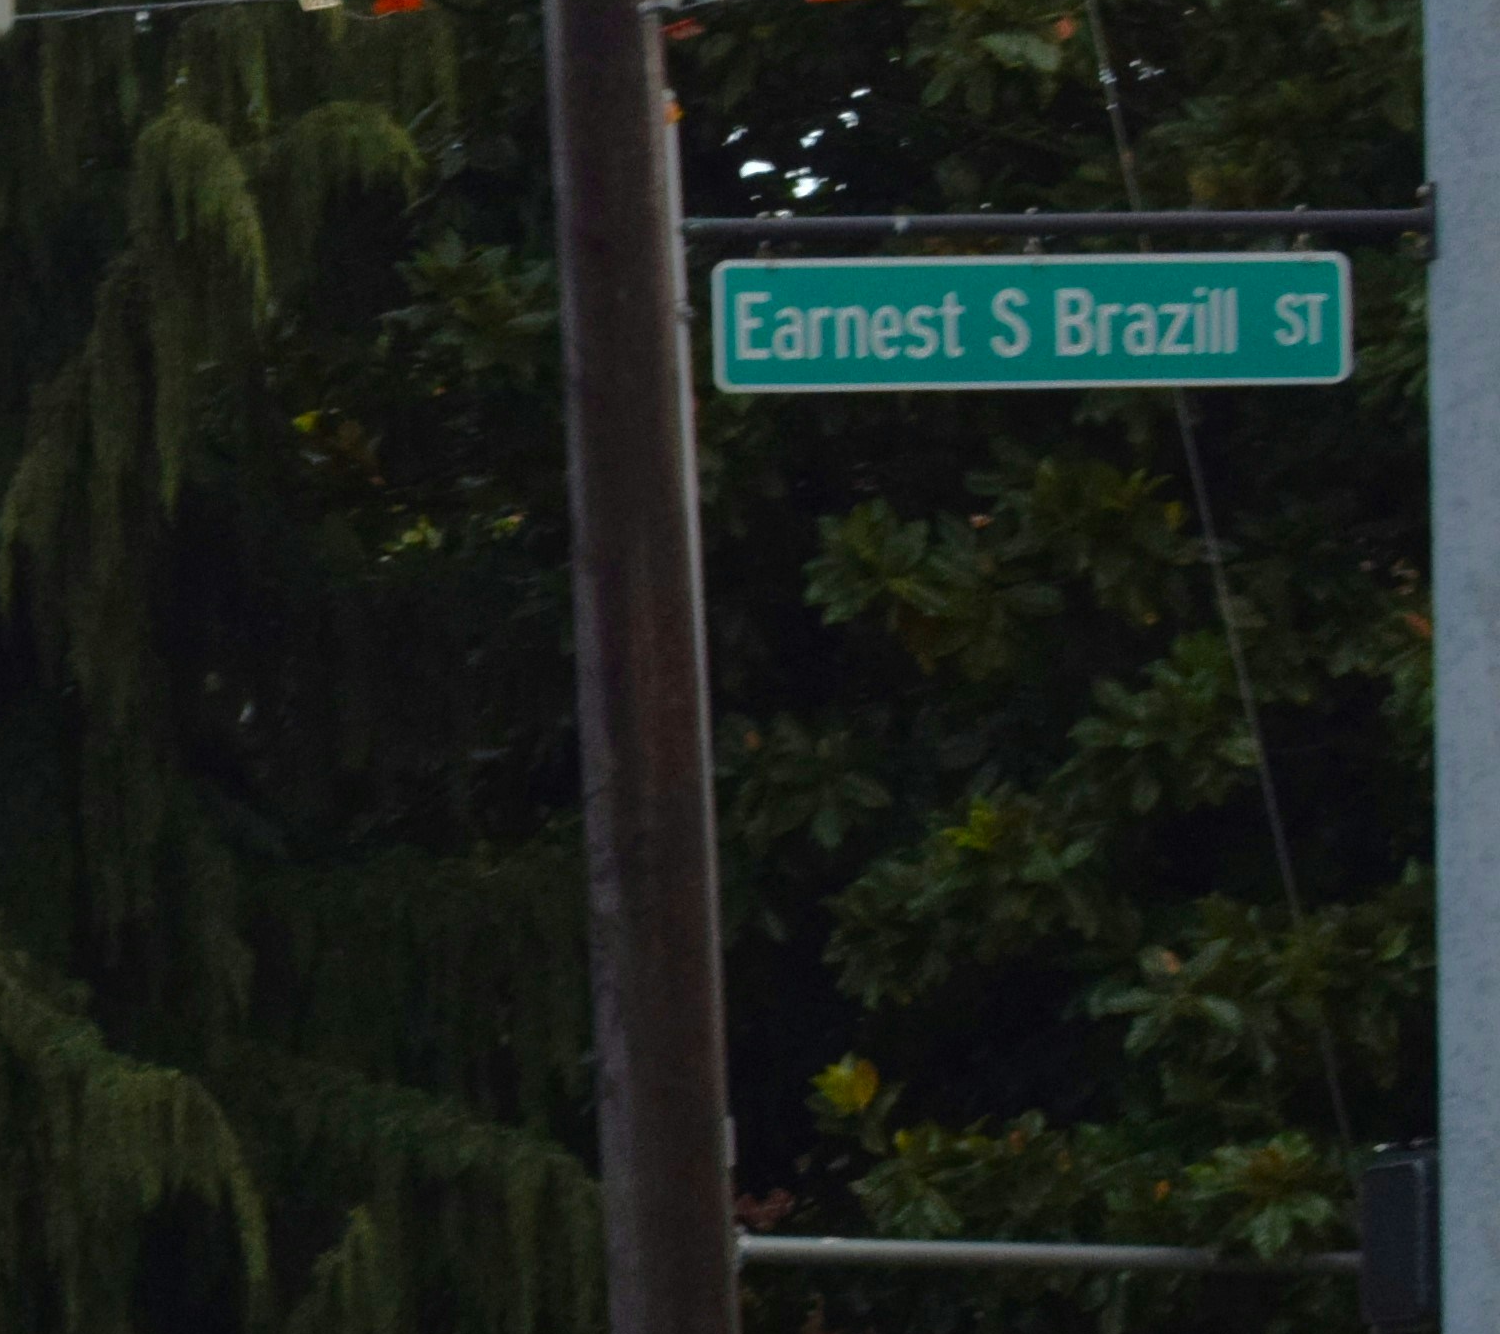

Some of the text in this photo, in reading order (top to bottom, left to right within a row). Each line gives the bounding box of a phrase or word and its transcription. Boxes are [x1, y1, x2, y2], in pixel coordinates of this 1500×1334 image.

[735, 286, 1328, 361] Earnest S Brazill ST
